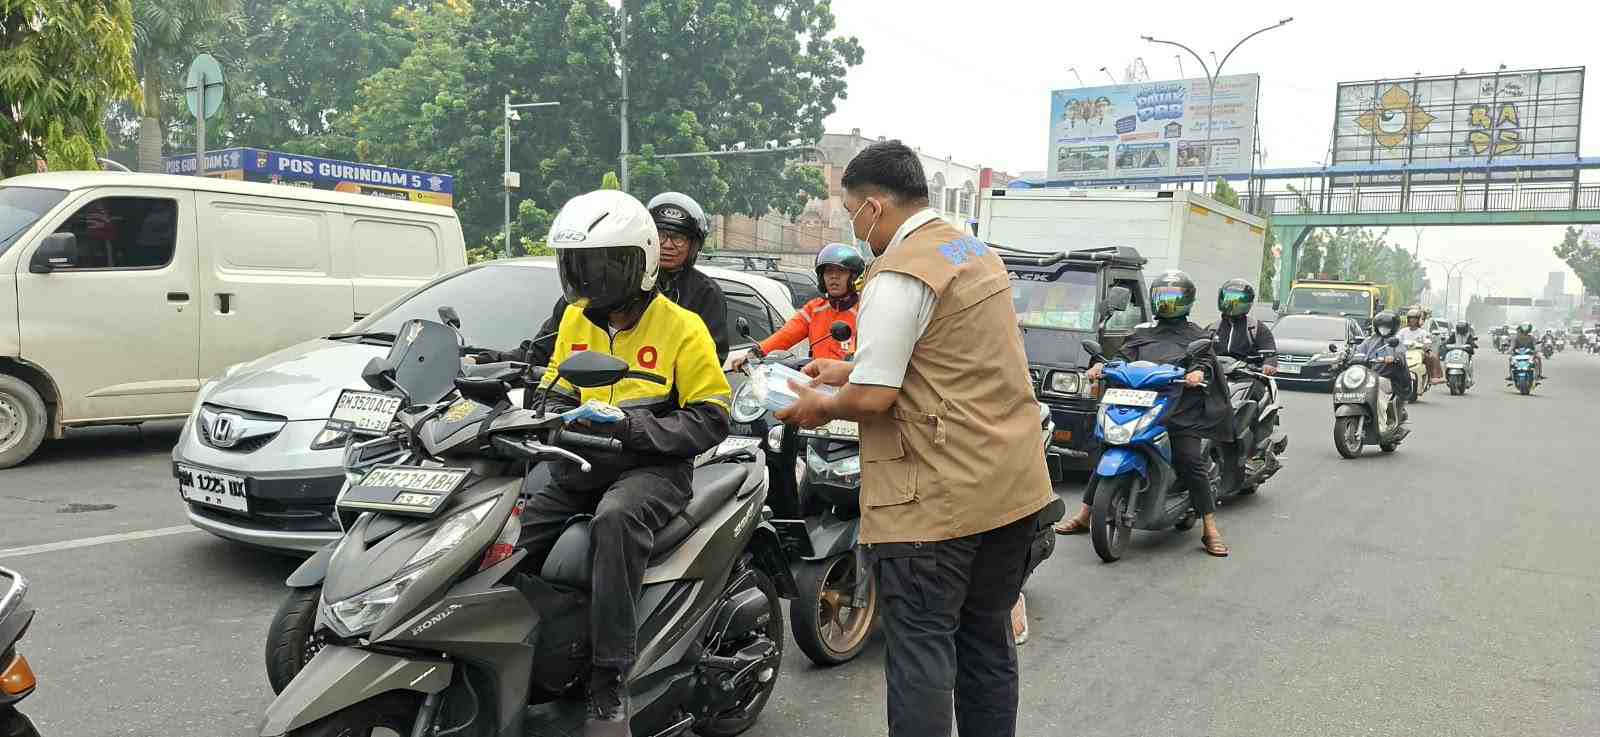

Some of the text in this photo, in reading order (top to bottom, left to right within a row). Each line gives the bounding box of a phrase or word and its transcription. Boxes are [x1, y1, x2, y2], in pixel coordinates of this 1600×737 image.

[166, 159, 182, 173] POS
[223, 153, 229, 168] 5
[277, 157, 314, 174] POS
[319, 163, 408, 187] GURINDAM
[411, 176, 422, 188] 5
[410, 603, 463, 636] HONDA
